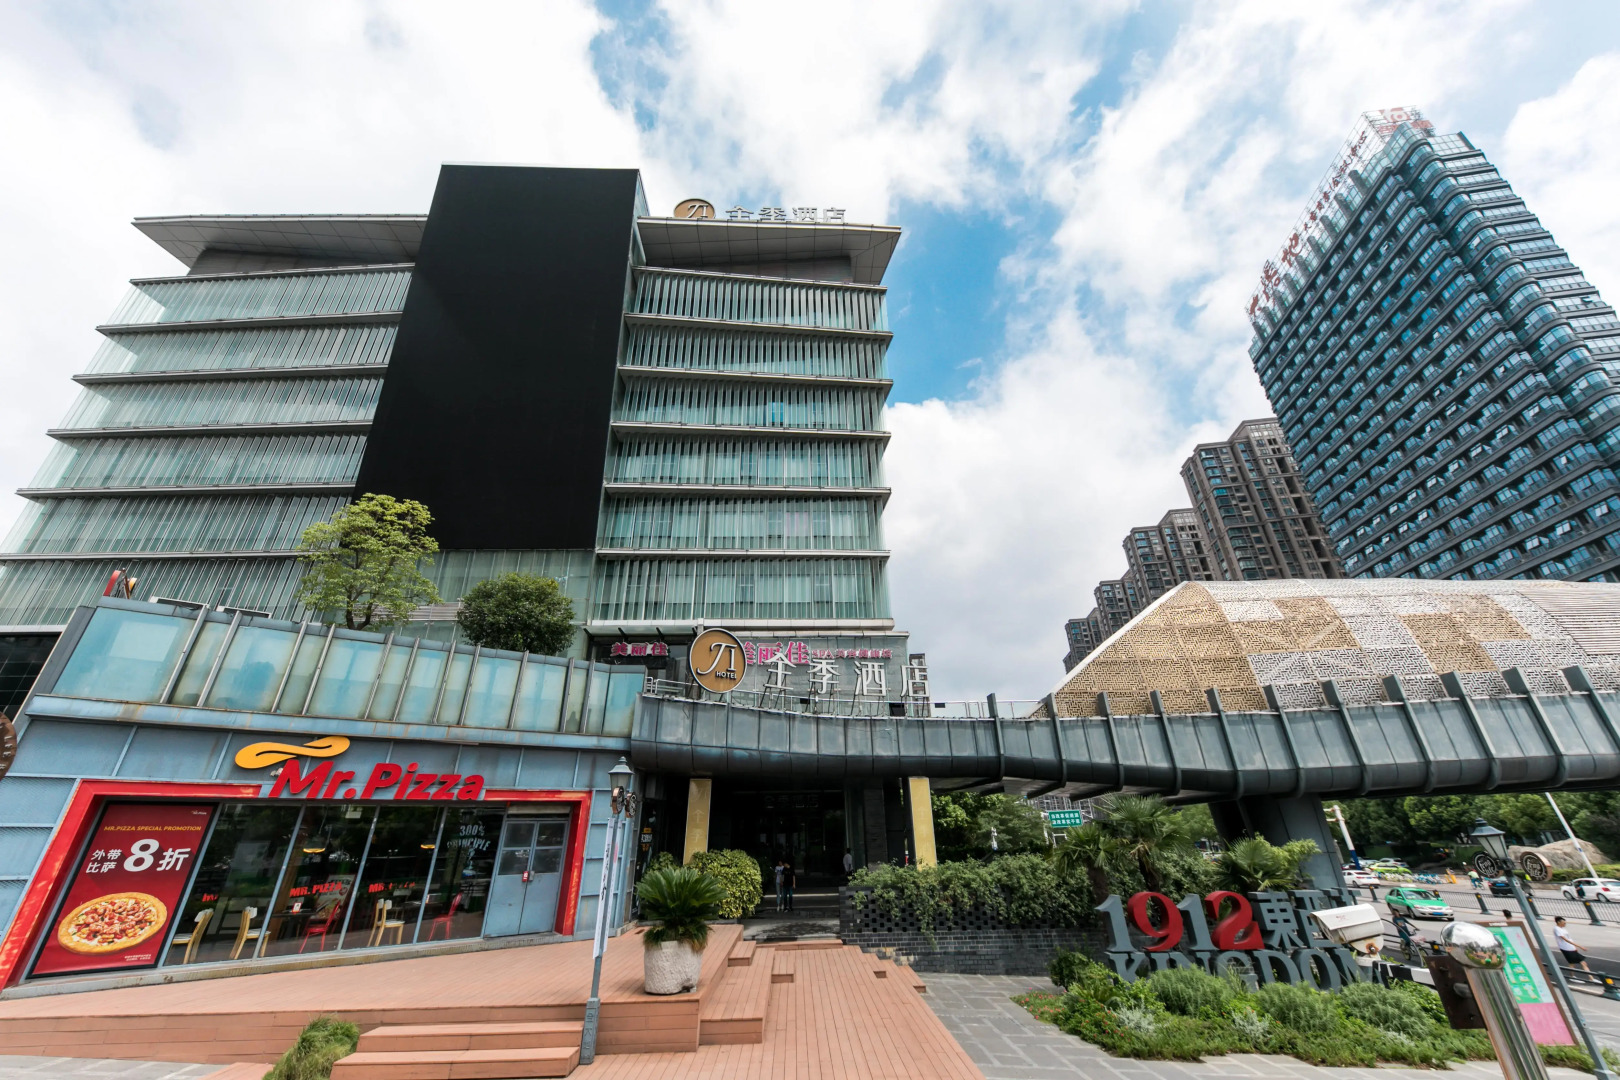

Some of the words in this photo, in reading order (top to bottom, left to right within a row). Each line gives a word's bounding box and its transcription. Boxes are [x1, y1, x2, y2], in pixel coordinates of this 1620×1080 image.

[725, 205, 846, 223] 全季酒店
[610, 642, 669, 656] 美丽佳
[716, 671, 737, 680] HOTEL
[763, 652, 930, 697] 全季酒店
[91, 848, 122, 861] 外带
[86, 861, 117, 874] 比萨
[312, 881, 342, 895] PIZZA
